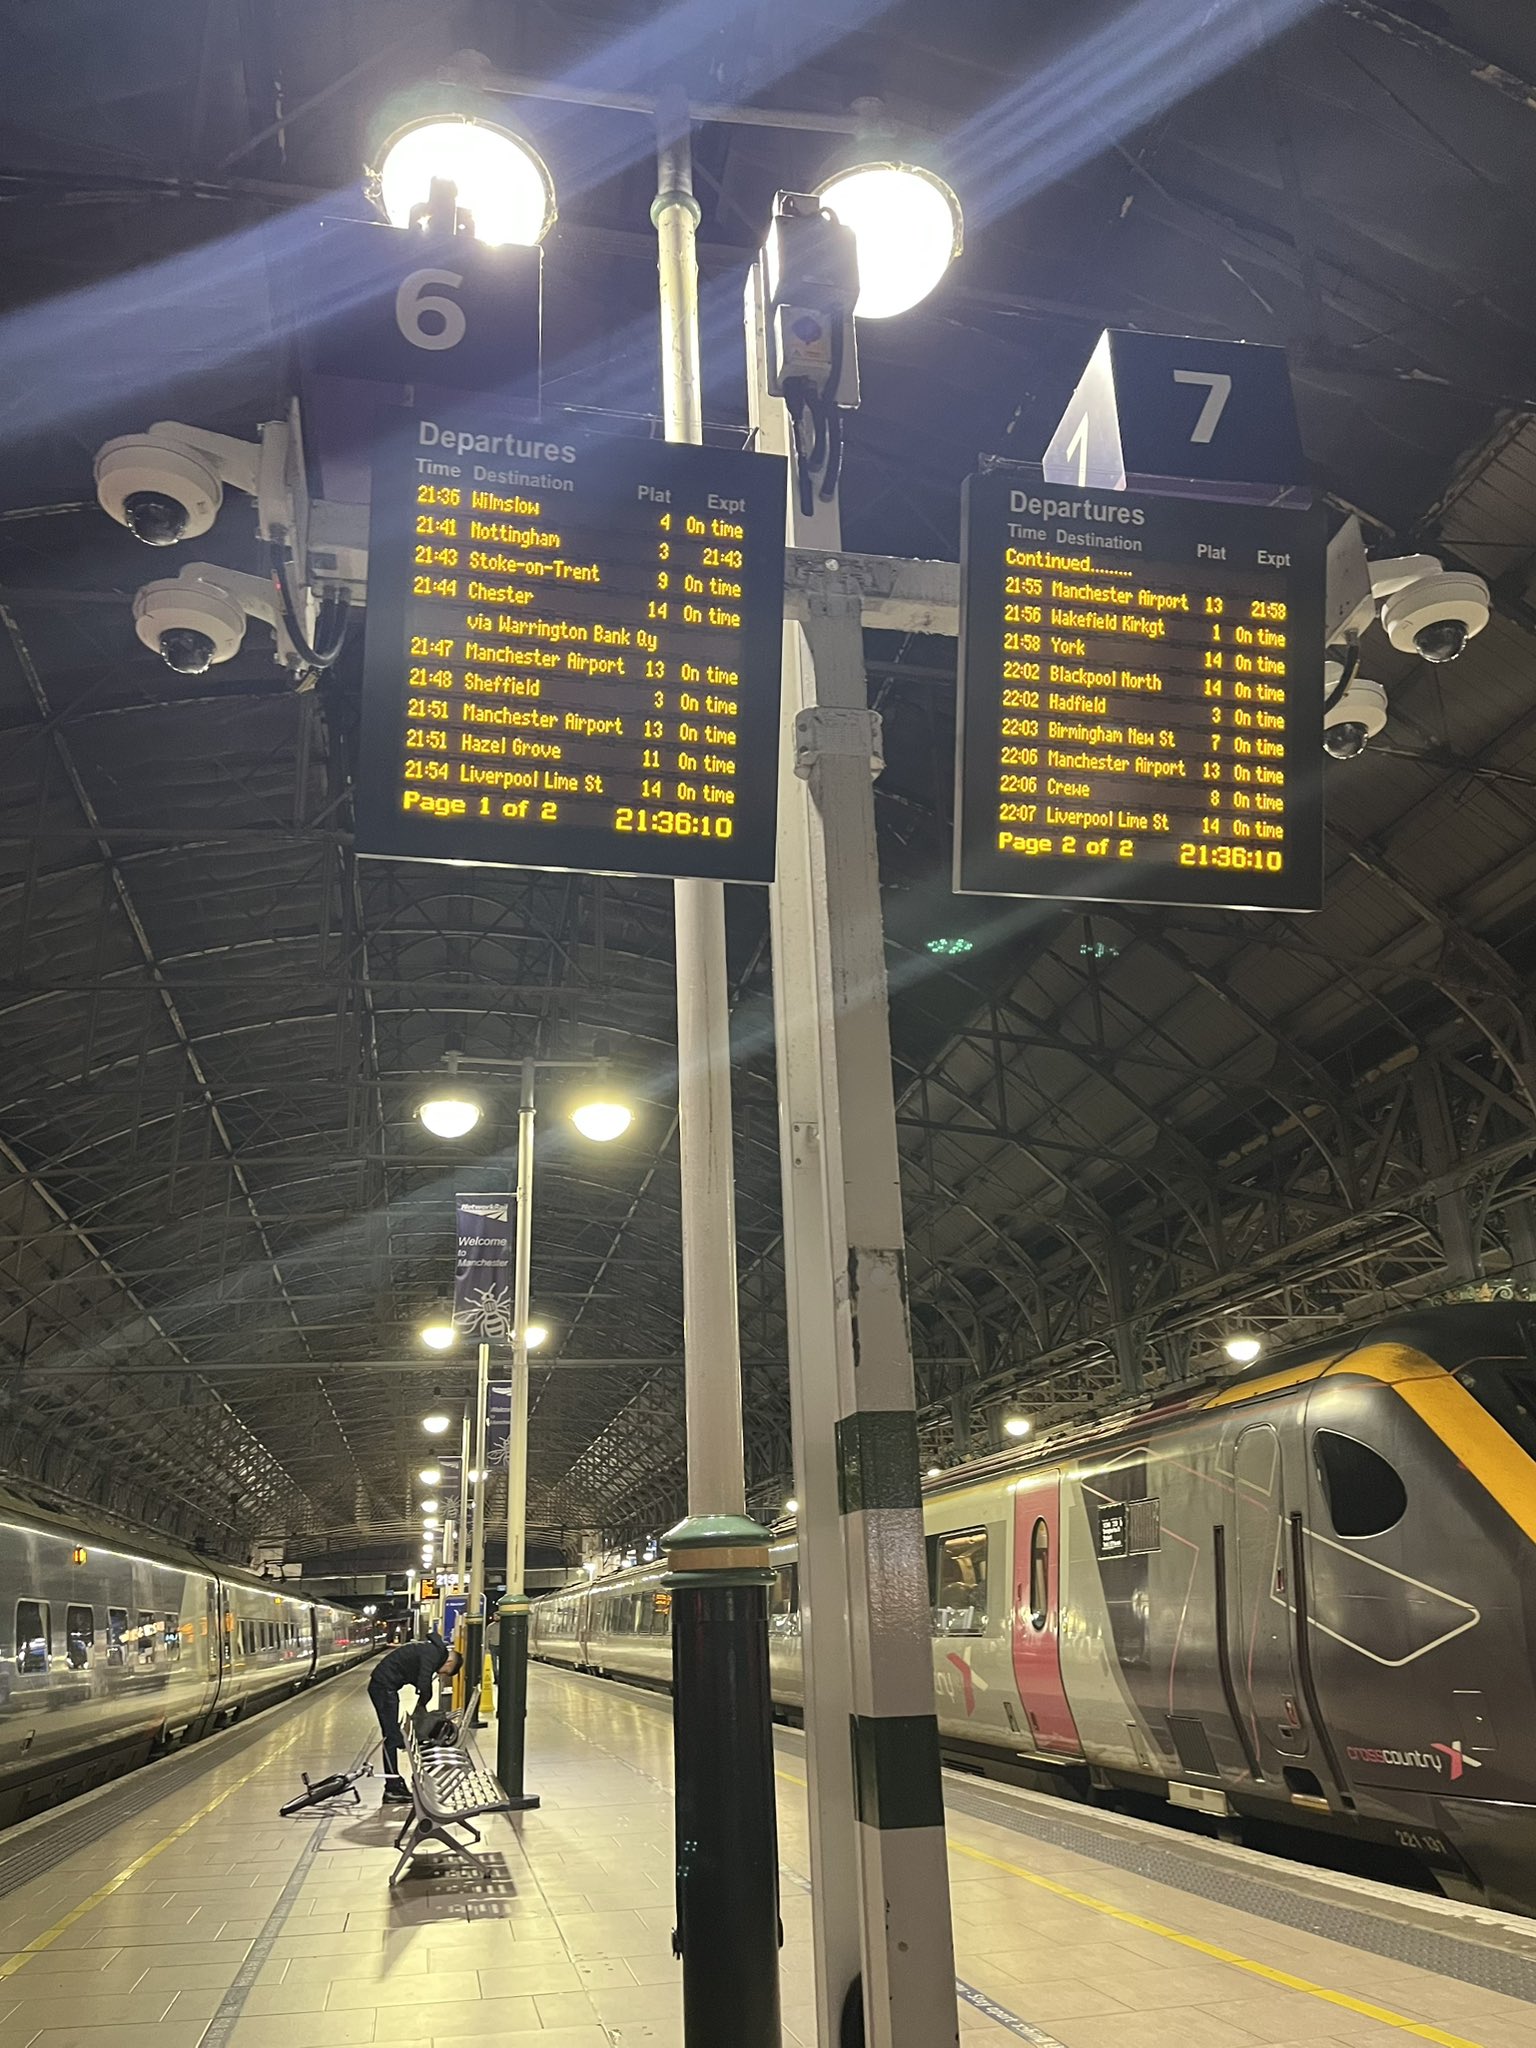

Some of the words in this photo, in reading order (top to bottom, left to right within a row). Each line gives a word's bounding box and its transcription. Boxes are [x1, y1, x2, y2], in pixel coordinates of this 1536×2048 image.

[396, 268, 466, 350] 6
[1173, 369, 1232, 443] 7
[418, 420, 577, 464] Departures
[415, 457, 462, 478] Time
[473, 465, 574, 492] Destination
[637, 485, 671, 504] Plat
[707, 494, 746, 514] Expt
[417, 486, 461, 507] 21:36
[471, 492, 541, 516] Wilmslow
[659, 514, 671, 529] 4
[686, 516, 706, 535] On
[710, 520, 744, 539] time
[1010, 490, 1145, 526] Departures
[416, 516, 458, 537] 21:41
[469, 521, 561, 549] Nottingham
[660, 543, 670, 560] 3
[702, 548, 742, 569] 21:43
[1007, 523, 1047, 541] Time
[1056, 529, 1143, 552] Destination
[1197, 543, 1226, 561] Plat
[1257, 550, 1291, 568] Expt
[415, 545, 459, 567] 21:43
[469, 552, 600, 582] Stoke-on-Trent
[657, 572, 669, 590] 9
[683, 575, 704, 593] On
[708, 579, 742, 598] time
[413, 576, 458, 597] 21:44
[467, 582, 534, 605] Chester
[648, 602, 668, 619] 14
[682, 606, 702, 623] On
[707, 608, 741, 627] time
[1004, 577, 1043, 596] 21:55
[1050, 581, 1134, 606] Manchester
[1137, 589, 1190, 611] Airport
[1204, 596, 1224, 614] 13
[1250, 600, 1287, 621] 21:58
[466, 616, 494, 632] via
[497, 615, 589, 642] Warrington
[592, 624, 630, 645] Bank
[1004, 605, 1042, 624] 21:56
[1049, 608, 1118, 632] Wakefield
[1121, 614, 1166, 639] Kirkgt
[1212, 623, 1221, 642] 1
[1234, 626, 1253, 645] On
[1255, 628, 1287, 648] time
[410, 636, 455, 658] 21:47
[464, 642, 560, 668] Manchester
[566, 652, 625, 675] Airport
[645, 660, 665, 679] 13
[680, 664, 700, 682] On
[705, 667, 739, 686] time
[1003, 632, 1042, 652] 21:58
[1050, 638, 1086, 656] York
[1203, 651, 1223, 669] 14
[1233, 654, 1253, 673] On
[1254, 655, 1286, 675] time
[408, 668, 454, 689] 21:48
[463, 672, 541, 697] Sheffield
[655, 692, 664, 708] 3
[679, 693, 700, 712] On
[704, 696, 738, 715] time
[1002, 661, 1041, 681] 22:02
[1049, 664, 1118, 688] Blackpool
[1119, 671, 1162, 691] North
[1203, 678, 1222, 697] 14
[1233, 681, 1253, 700] On
[1253, 683, 1286, 703] time
[407, 698, 449, 720] 21:51
[462, 703, 558, 729] Manchester
[564, 713, 622, 736] Airport
[644, 721, 664, 738] 13
[678, 724, 699, 742] On
[703, 726, 737, 745] time
[1002, 689, 1040, 709] 22:02
[1048, 693, 1107, 715] Hadfield
[1211, 707, 1222, 724] 3
[1233, 708, 1253, 727] On
[1253, 710, 1286, 730] time
[406, 729, 448, 751] 21:51
[460, 734, 507, 755] Hazel
[511, 739, 562, 760] Grove
[642, 749, 660, 768] 11
[677, 752, 698, 771] On
[703, 756, 736, 774] time
[1001, 718, 1039, 737] 22:03
[1047, 720, 1124, 745] Birmingham
[1126, 728, 1155, 746] New
[1158, 730, 1175, 748] St
[1211, 733, 1222, 751] 7
[1233, 736, 1252, 755] On
[1253, 738, 1285, 757] time
[404, 760, 450, 780] 21:54
[459, 764, 540, 790] Liverpool
[543, 773, 579, 791] Lime
[584, 775, 603, 793] St
[641, 780, 662, 798] 14
[676, 782, 697, 801] On
[702, 784, 736, 804] time
[1000, 747, 1039, 766] 22:06
[1047, 749, 1130, 773] Manchester
[1134, 756, 1186, 778] Airport
[1202, 762, 1221, 780] 13
[1233, 764, 1252, 782] On
[1254, 766, 1285, 785] time
[402, 790, 467, 817] Page
[479, 796, 491, 815] 1
[501, 799, 530, 818] of
[540, 801, 558, 820] 2
[614, 807, 733, 838] 21:36:10
[999, 774, 1038, 794] 22:06
[1046, 778, 1091, 798] Crewe
[1209, 790, 1221, 807] 8
[1232, 790, 1251, 810] On
[1254, 793, 1285, 812] time
[998, 802, 1038, 822] 22:07
[1045, 807, 1114, 829] Liverpool
[1117, 811, 1149, 830] Lime
[1152, 814, 1169, 831] St
[1201, 817, 1220, 835] 14
[1231, 818, 1254, 838] On
[1253, 820, 1284, 840] time
[998, 831, 1053, 855] Page
[1060, 835, 1077, 854] 2
[1085, 837, 1110, 857] of
[1118, 839, 1134, 857] 2
[1179, 842, 1283, 872] 21:36:10
[457, 1249, 467, 1257] to
[457, 1259, 509, 1267] Manchester
[458, 1236, 507, 1247] Welcome
[1346, 1746, 1442, 1773] crosscountry
